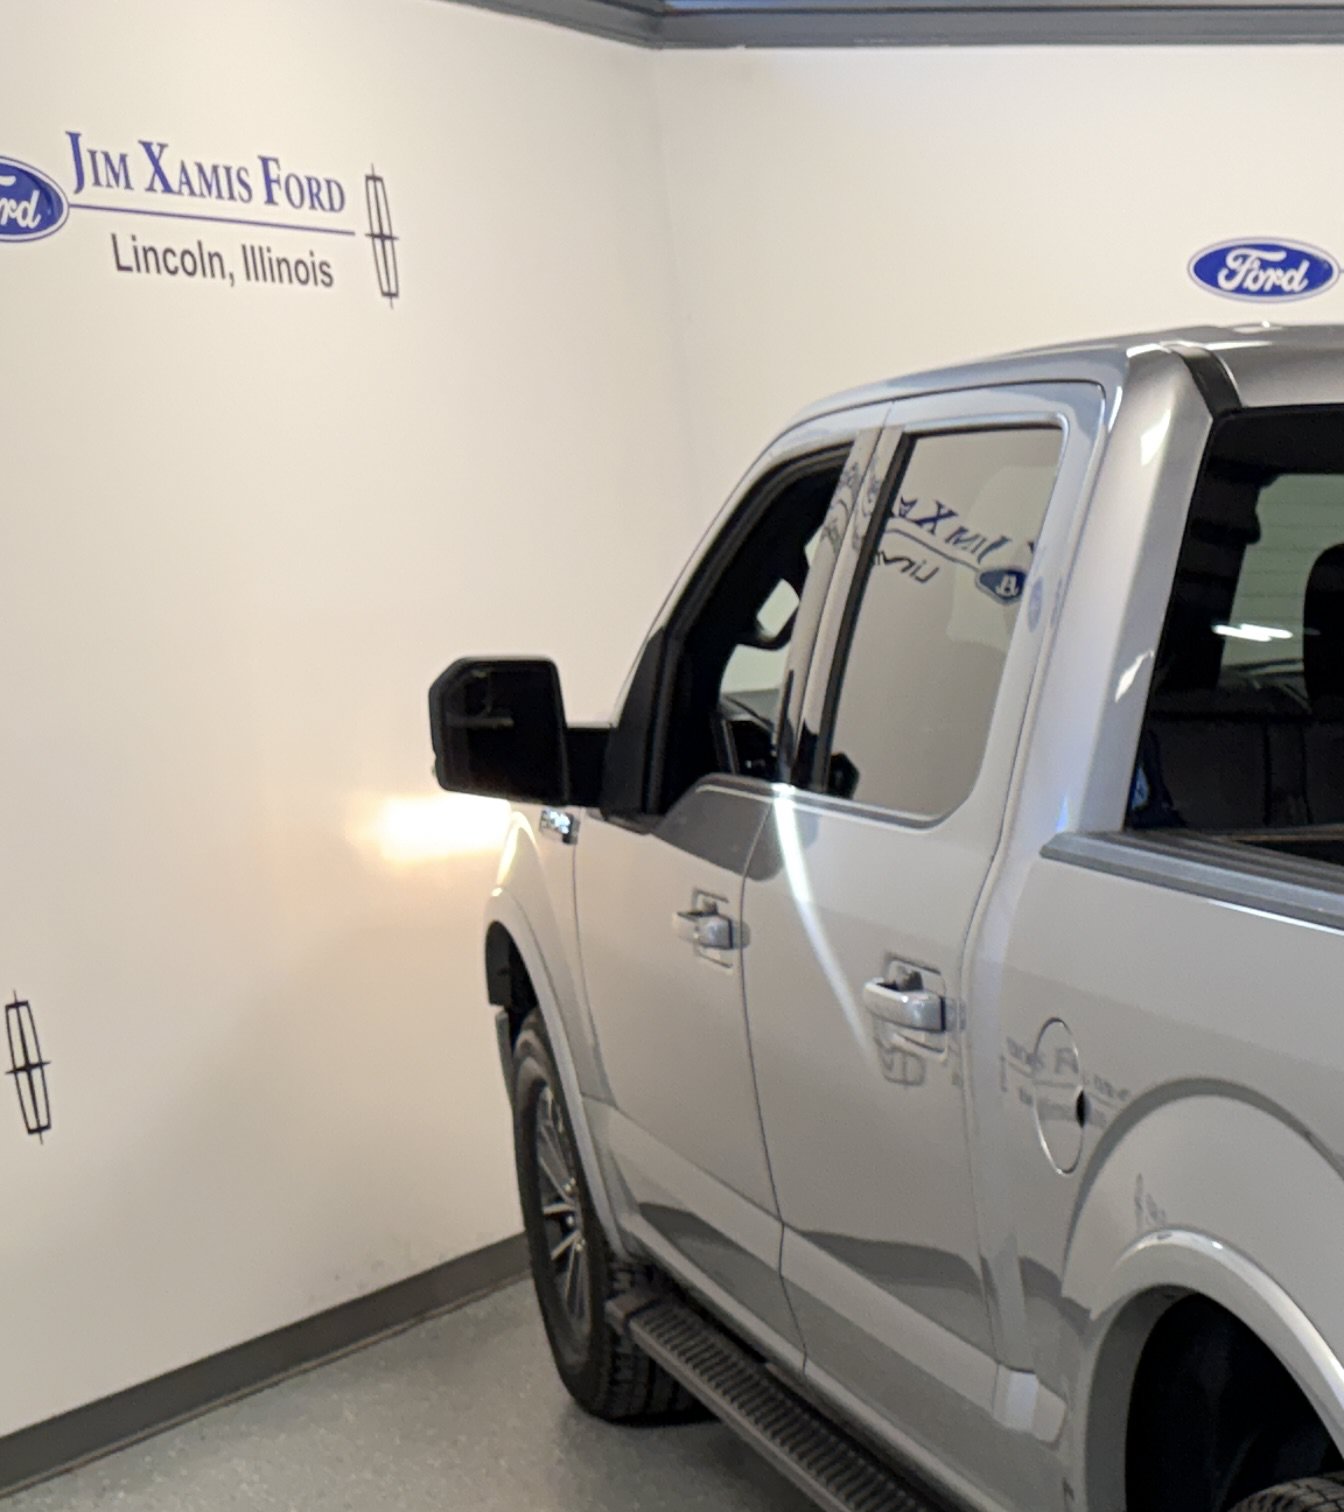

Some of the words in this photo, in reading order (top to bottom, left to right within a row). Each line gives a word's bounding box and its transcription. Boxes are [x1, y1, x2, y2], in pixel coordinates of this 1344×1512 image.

[65, 131, 135, 195] JIM
[137, 140, 254, 204] XAMIS
[257, 155, 346, 213] FORD
[111, 233, 236, 287] Lincoln,
[241, 244, 334, 288] Illinois
[1217, 247, 1310, 292] Ford
